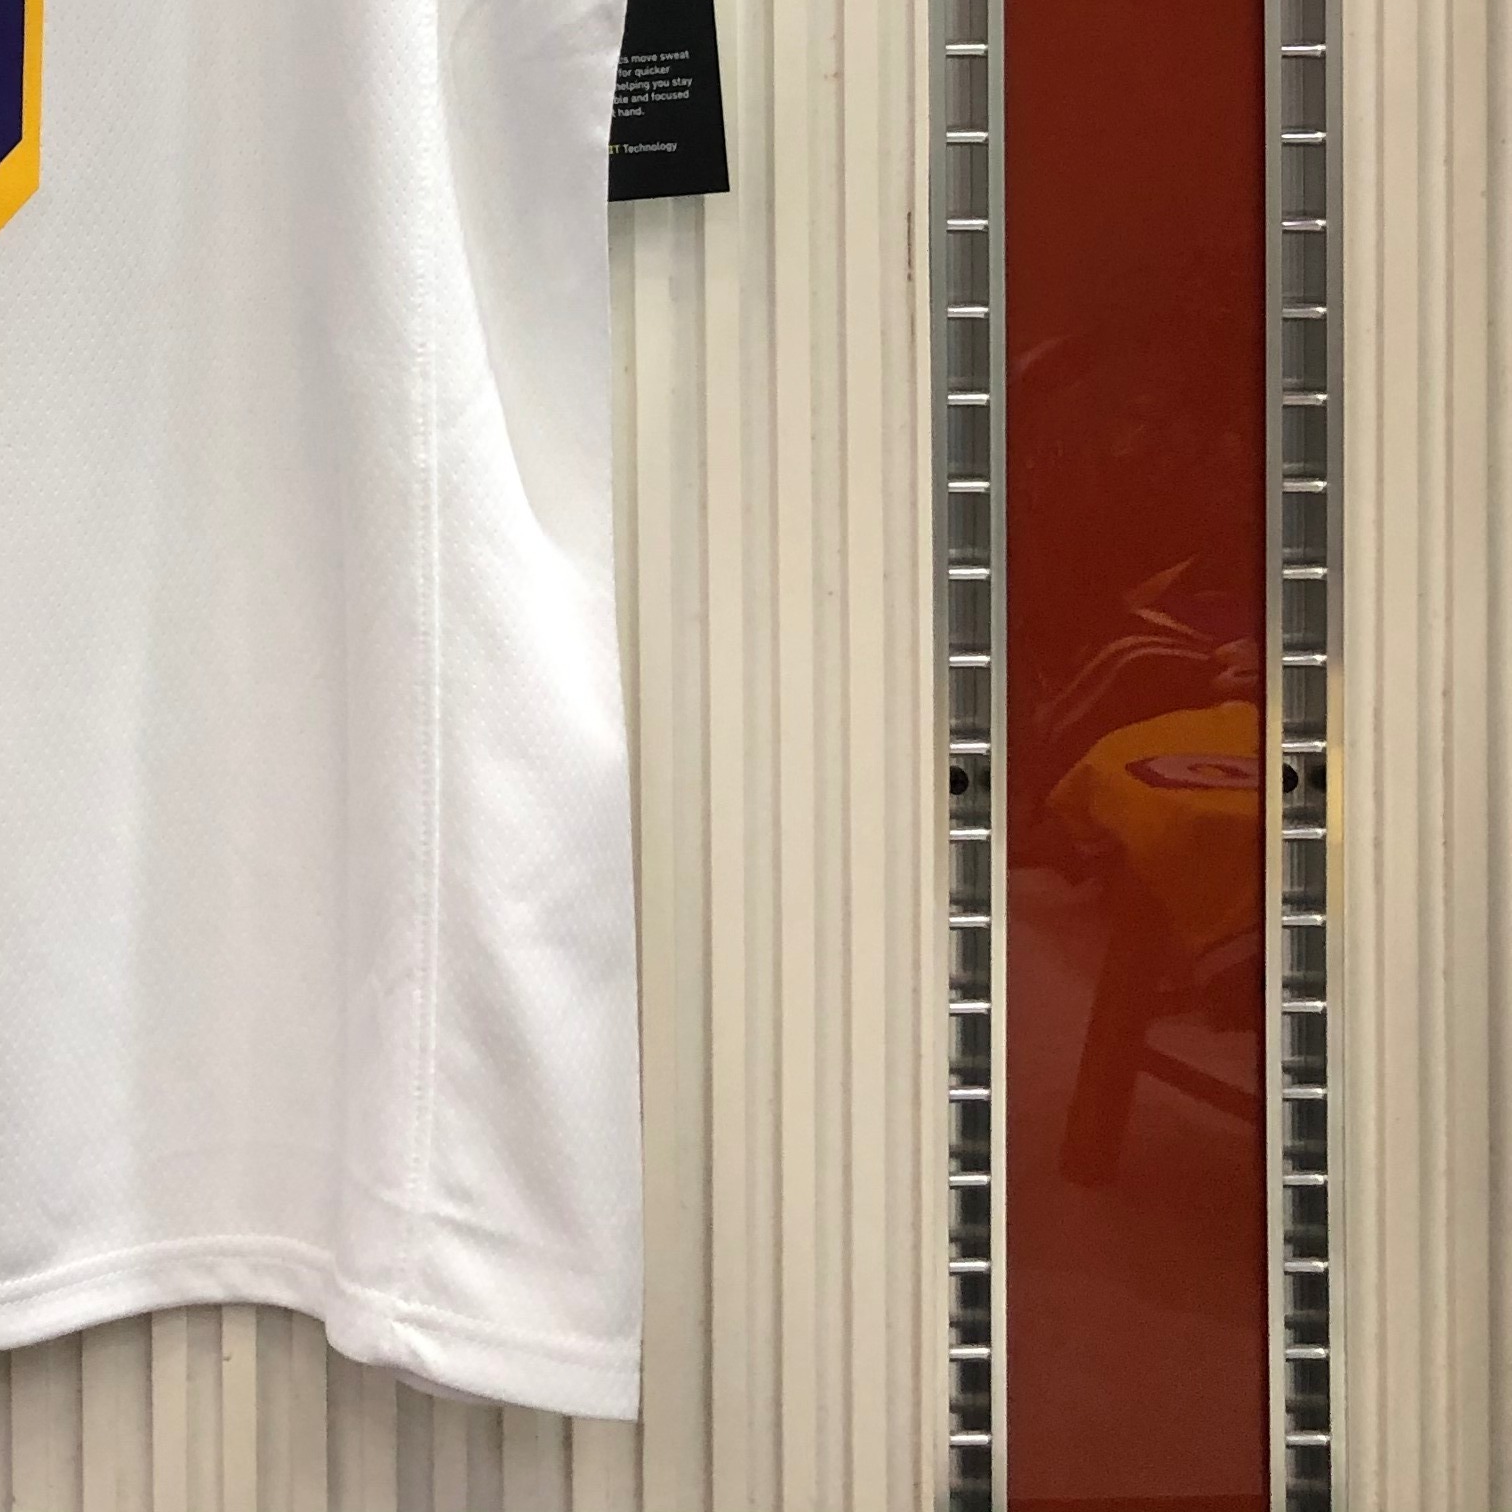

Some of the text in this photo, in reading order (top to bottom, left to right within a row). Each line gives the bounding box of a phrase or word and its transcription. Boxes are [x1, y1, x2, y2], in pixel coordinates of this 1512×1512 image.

[631, 54, 657, 63] move
[660, 50, 690, 61] sweat
[618, 66, 670, 78] for quicker
[651, 80, 670, 90] you
[671, 77, 693, 88] stay
[631, 93, 649, 103] and
[651, 90, 690, 101] focused
[623, 141, 677, 153] Technology
